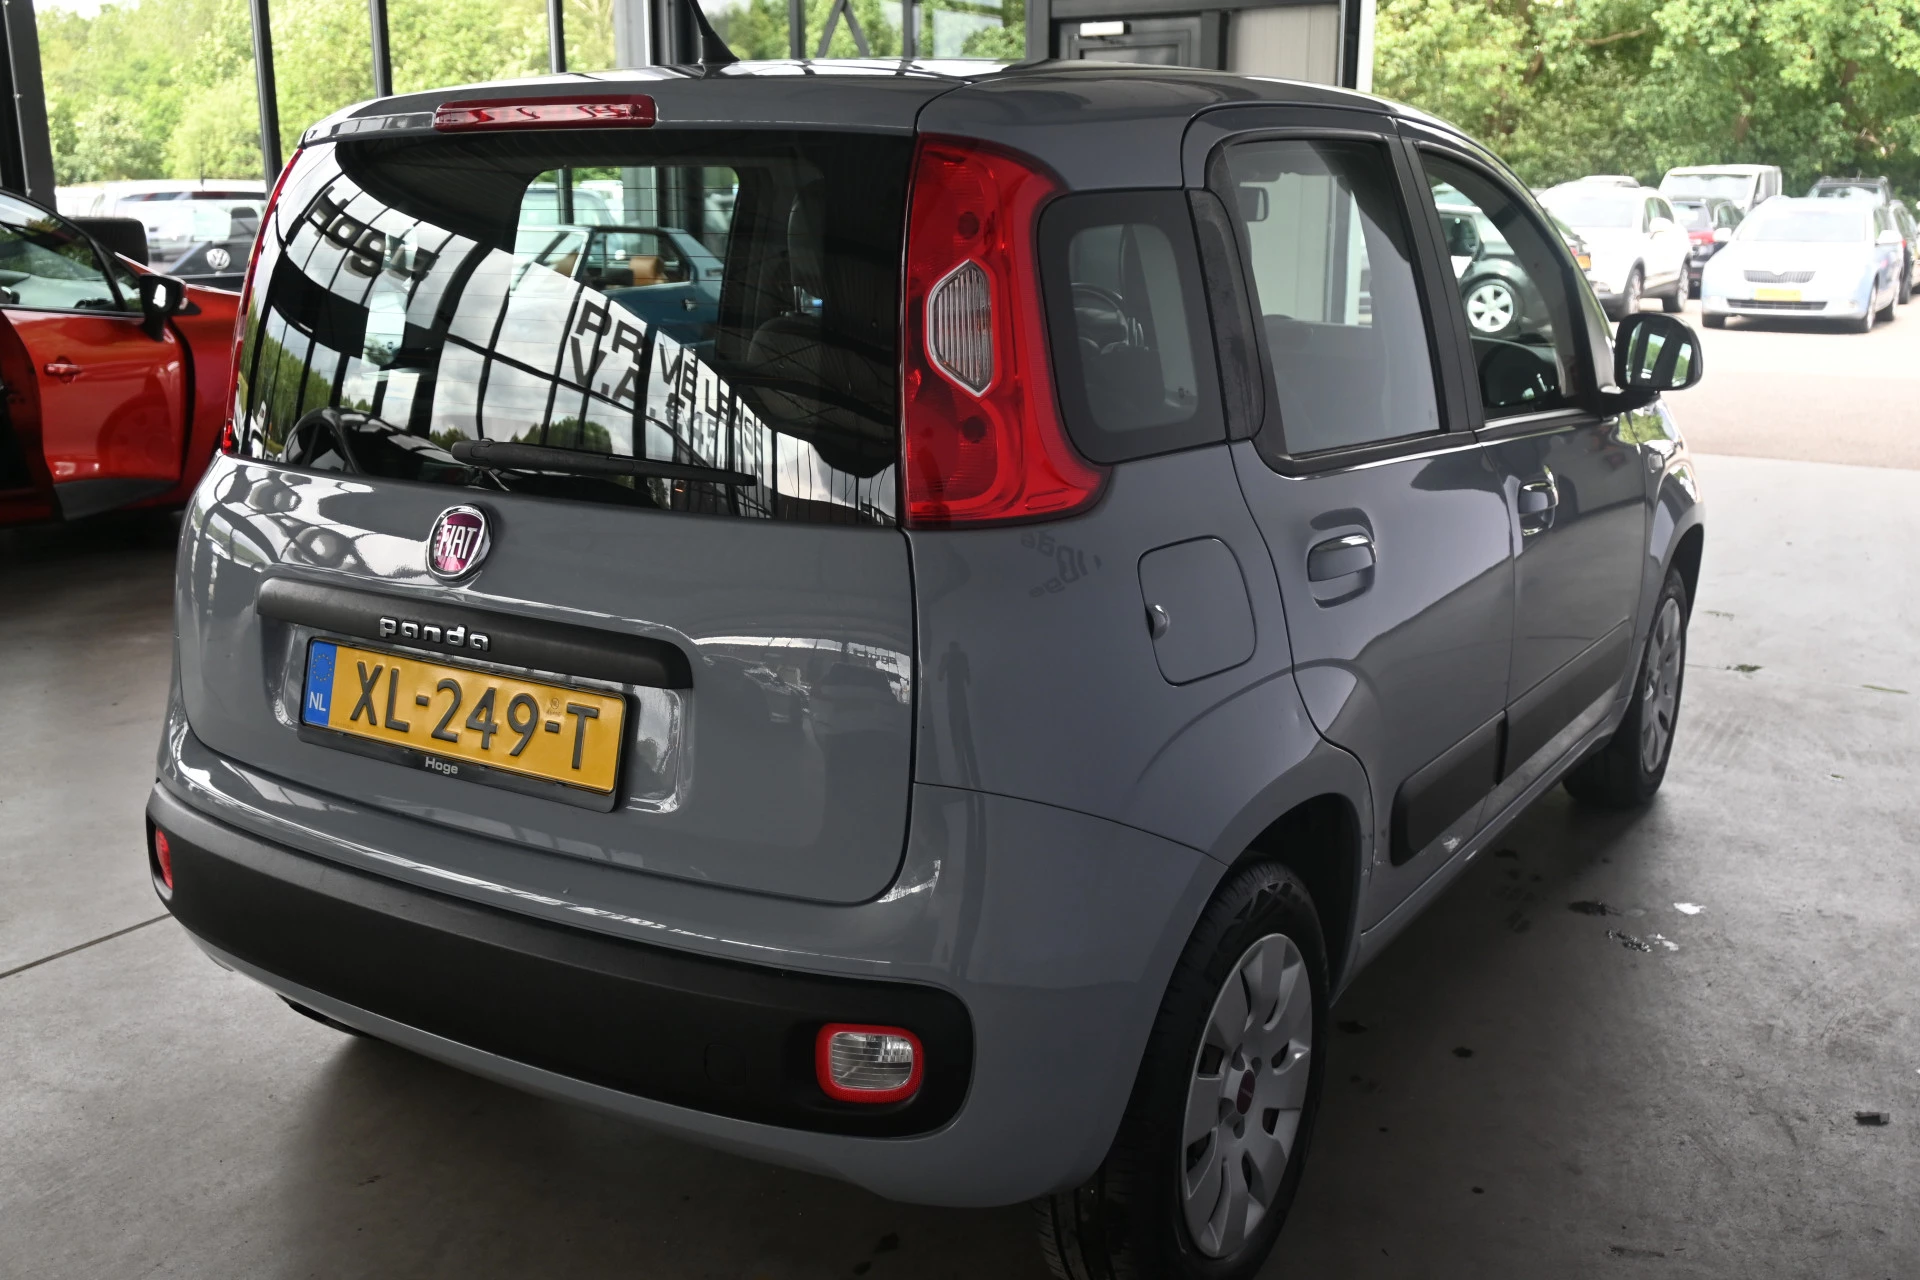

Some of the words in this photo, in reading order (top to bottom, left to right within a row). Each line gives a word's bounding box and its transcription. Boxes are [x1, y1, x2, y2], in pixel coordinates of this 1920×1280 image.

[438, 524, 478, 560] FIAT
[380, 616, 489, 652] panda
[309, 691, 327, 713] NL
[350, 660, 599, 770] XL-249-T
[425, 756, 459, 775] Hoge
